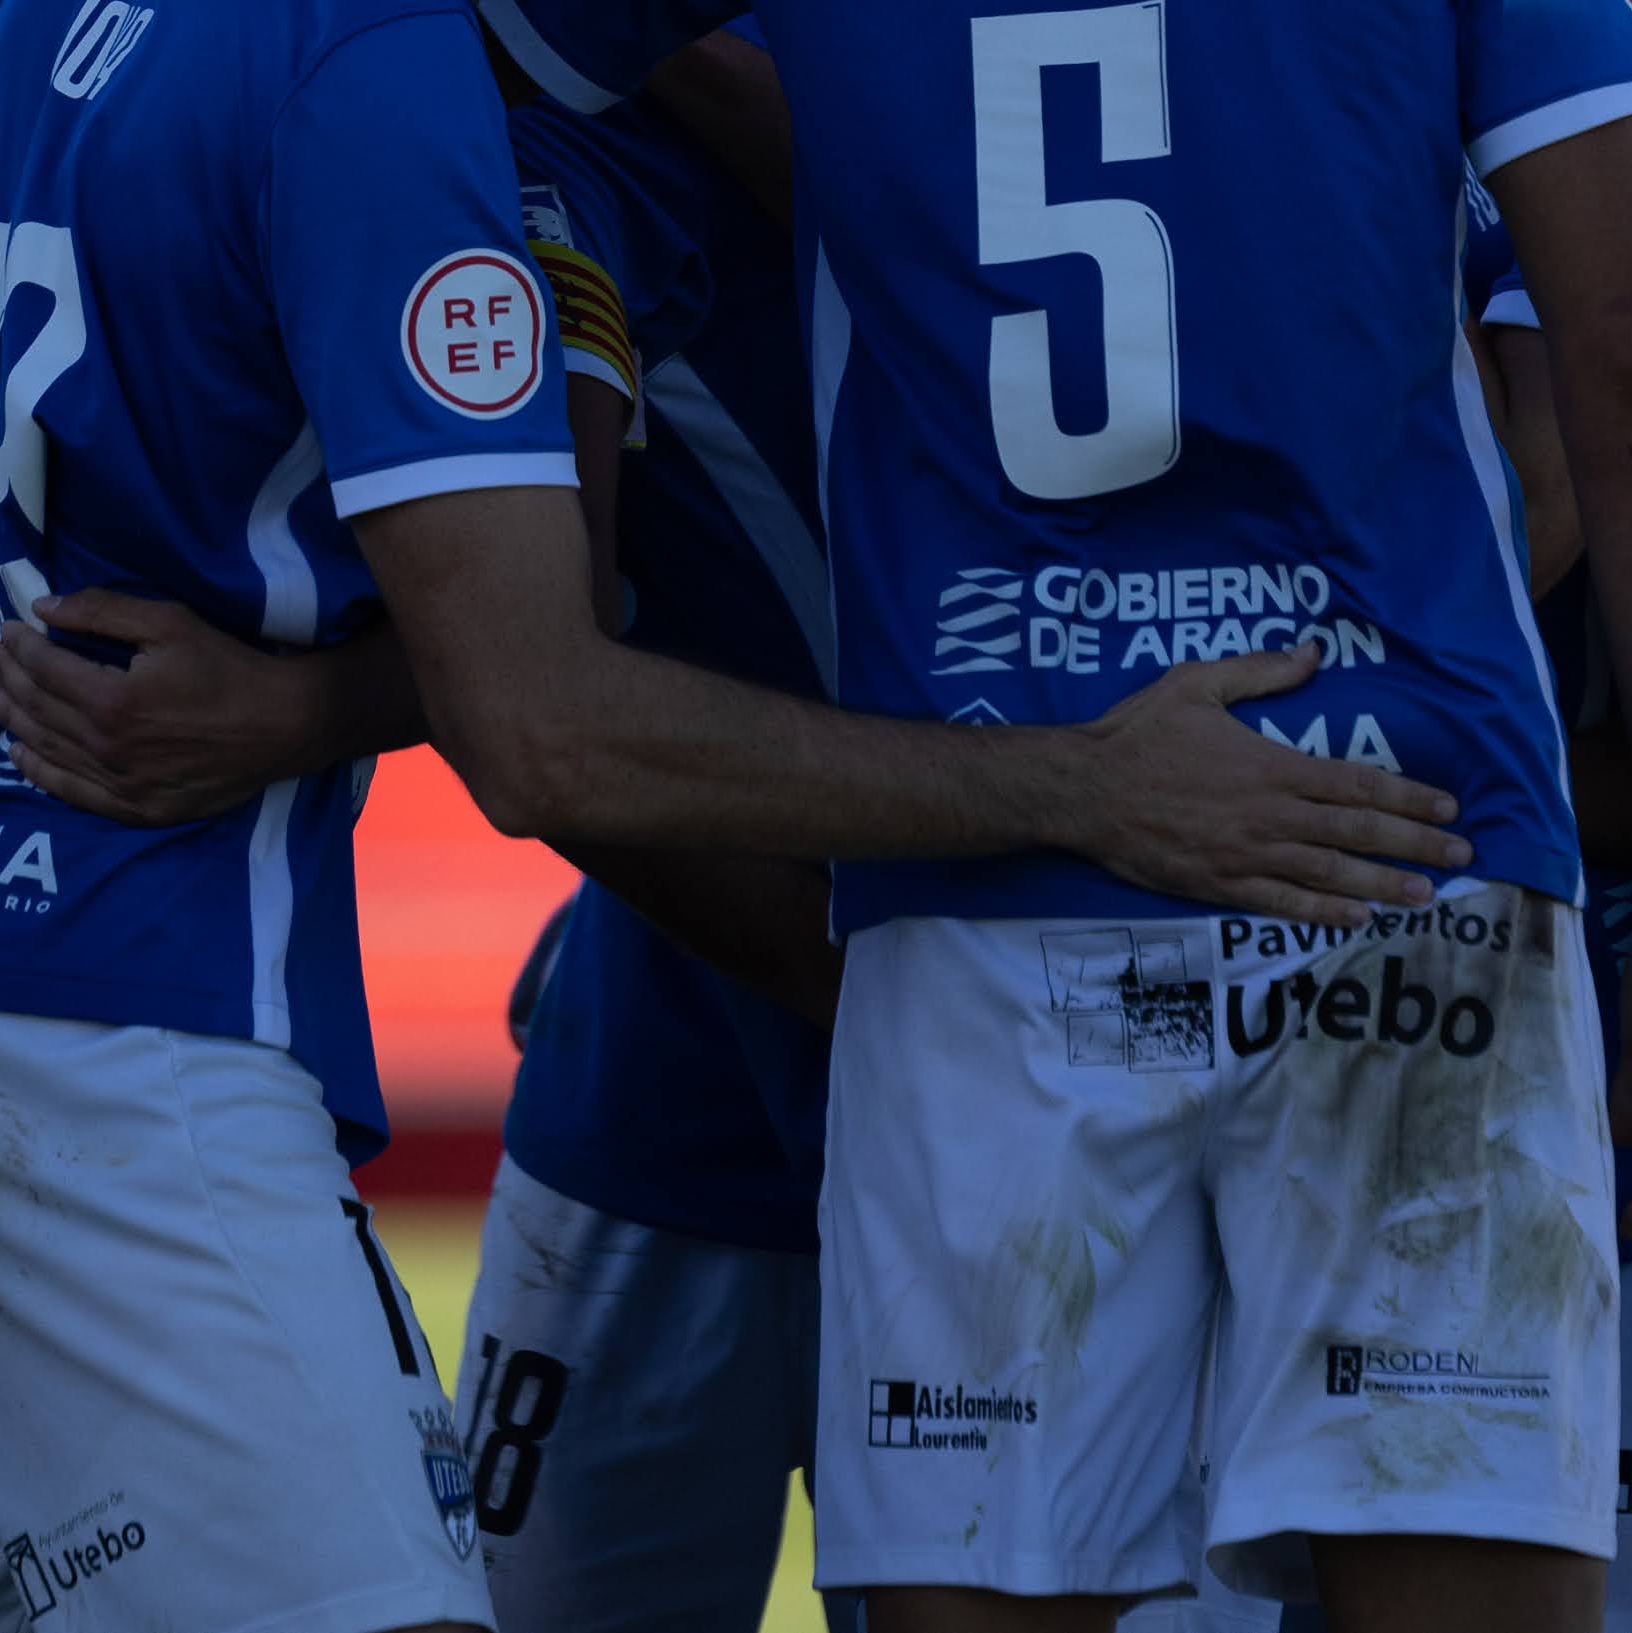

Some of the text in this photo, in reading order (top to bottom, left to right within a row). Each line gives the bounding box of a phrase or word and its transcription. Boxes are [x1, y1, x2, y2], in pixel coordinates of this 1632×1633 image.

[1033, 563, 1331, 622] GOBIERNO
[1028, 616, 1387, 675] DE ARAGON
[1226, 955, 1495, 1058] Utebo
[466, 1333, 570, 1537] 18
[49, 1520, 146, 1590] Utebo
